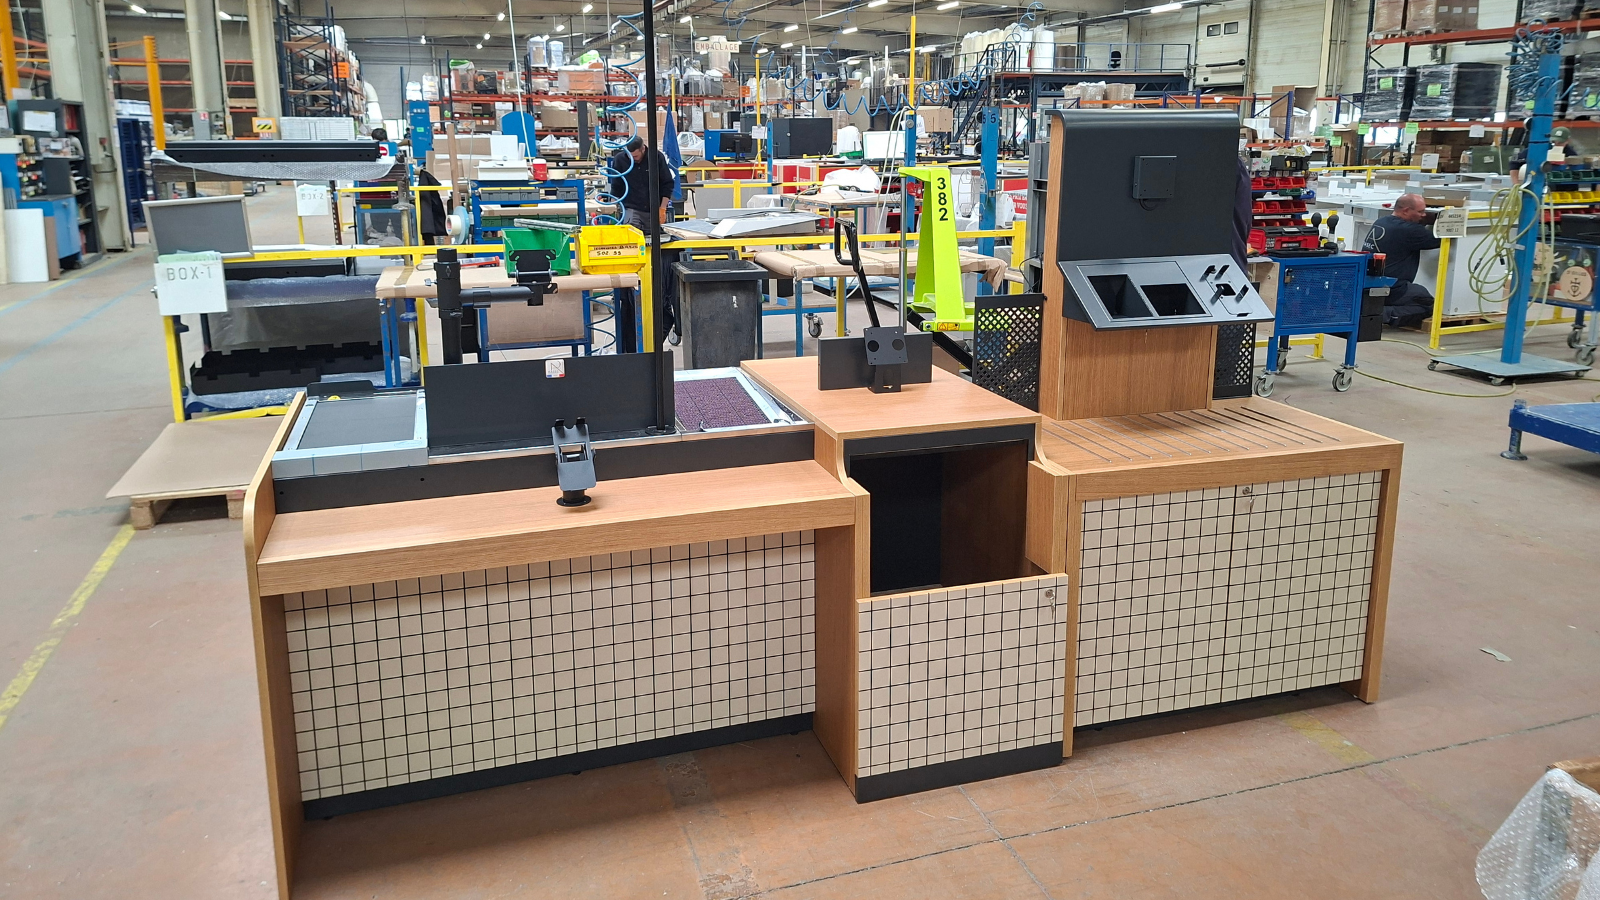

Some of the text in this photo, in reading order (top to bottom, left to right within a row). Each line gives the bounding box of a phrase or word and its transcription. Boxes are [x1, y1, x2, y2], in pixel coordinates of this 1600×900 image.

[695, 42, 738, 51] EMBALLAGE
[990, 113, 996, 124] 5
[937, 177, 949, 221] 382
[166, 266, 211, 281] BOX-1
